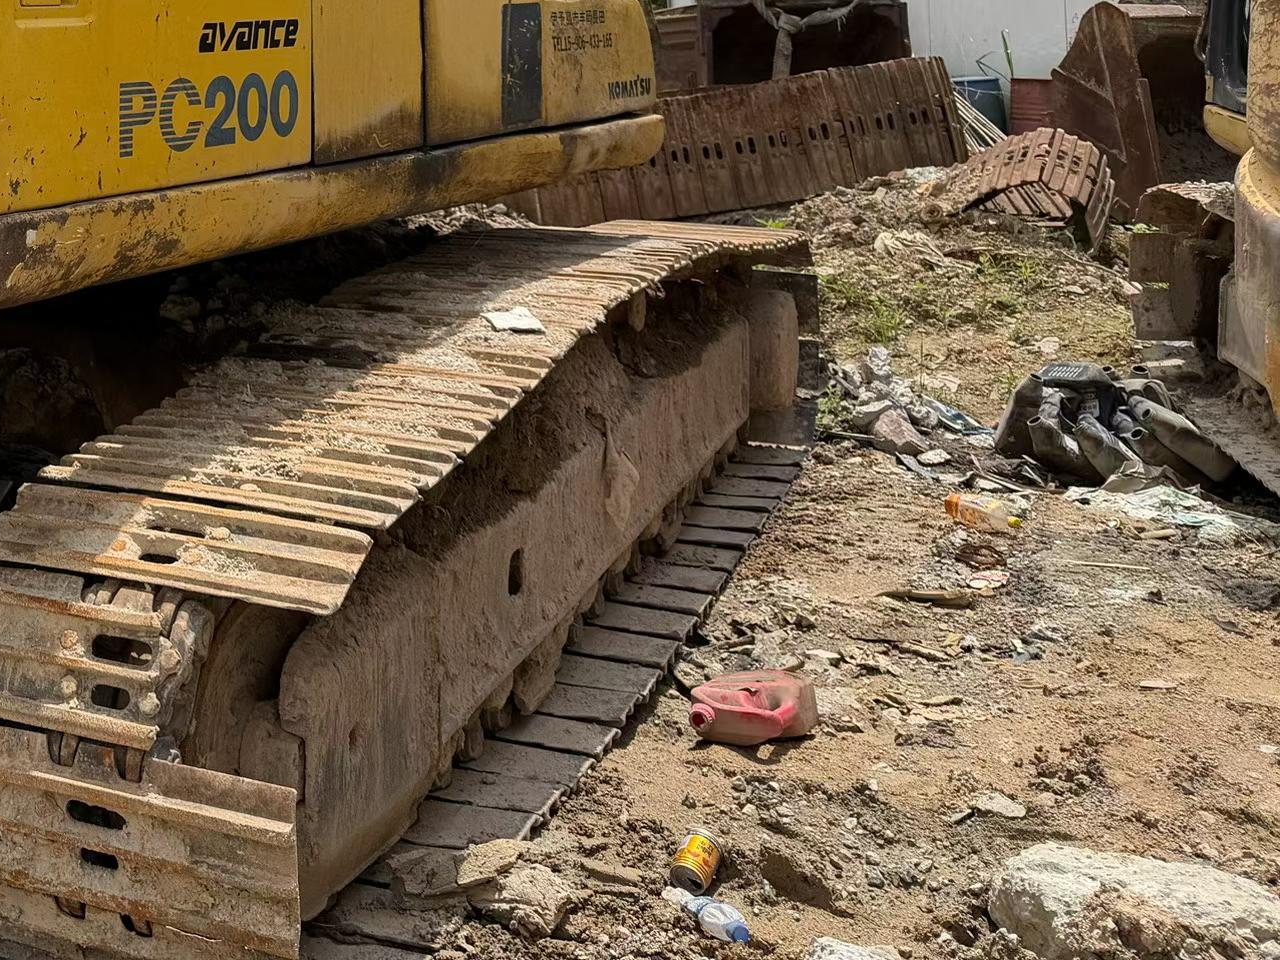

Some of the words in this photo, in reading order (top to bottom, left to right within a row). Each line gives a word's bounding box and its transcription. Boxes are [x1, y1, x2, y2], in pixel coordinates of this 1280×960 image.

[198, 18, 299, 53] avance
[608, 75, 651, 100] KOMATSU
[118, 69, 299, 158] PC200
